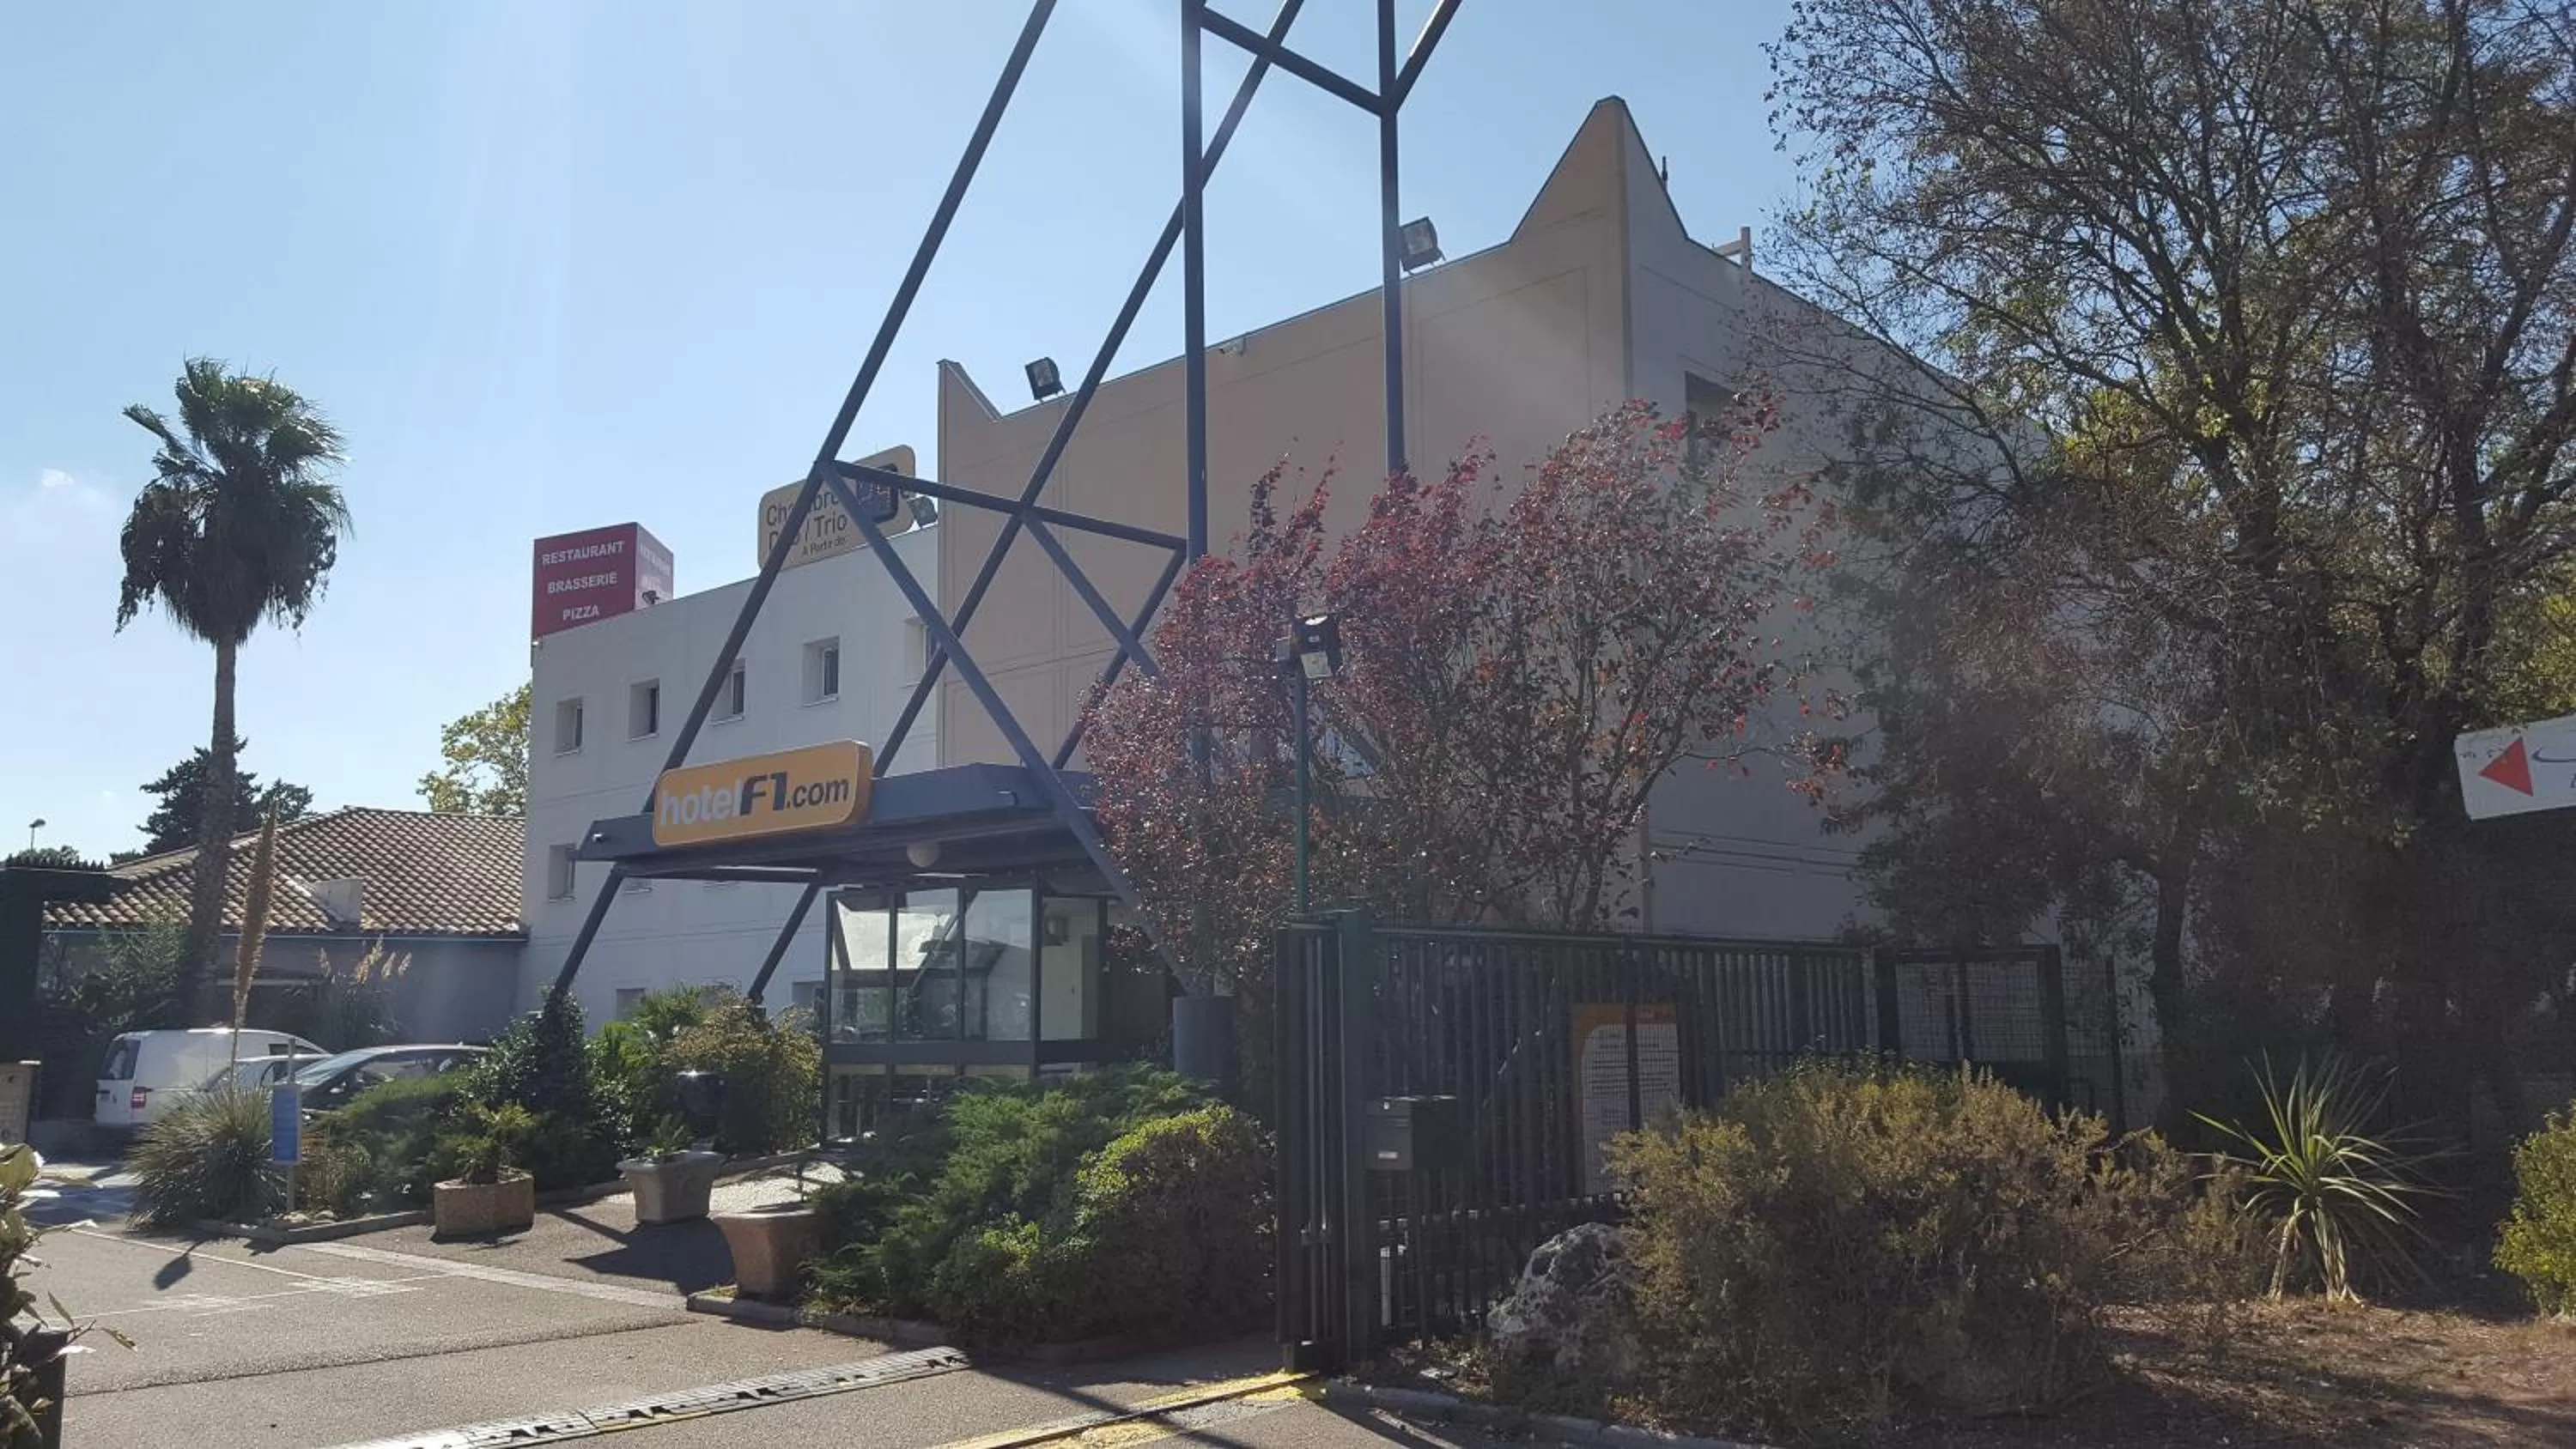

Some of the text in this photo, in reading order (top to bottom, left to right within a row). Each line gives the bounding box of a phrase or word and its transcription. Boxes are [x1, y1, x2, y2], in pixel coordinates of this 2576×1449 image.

[813, 511, 848, 538] Trio
[542, 540, 625, 567] RESTAURANT
[547, 571, 619, 595] BRASSERIE
[562, 604, 600, 621] PIZZA
